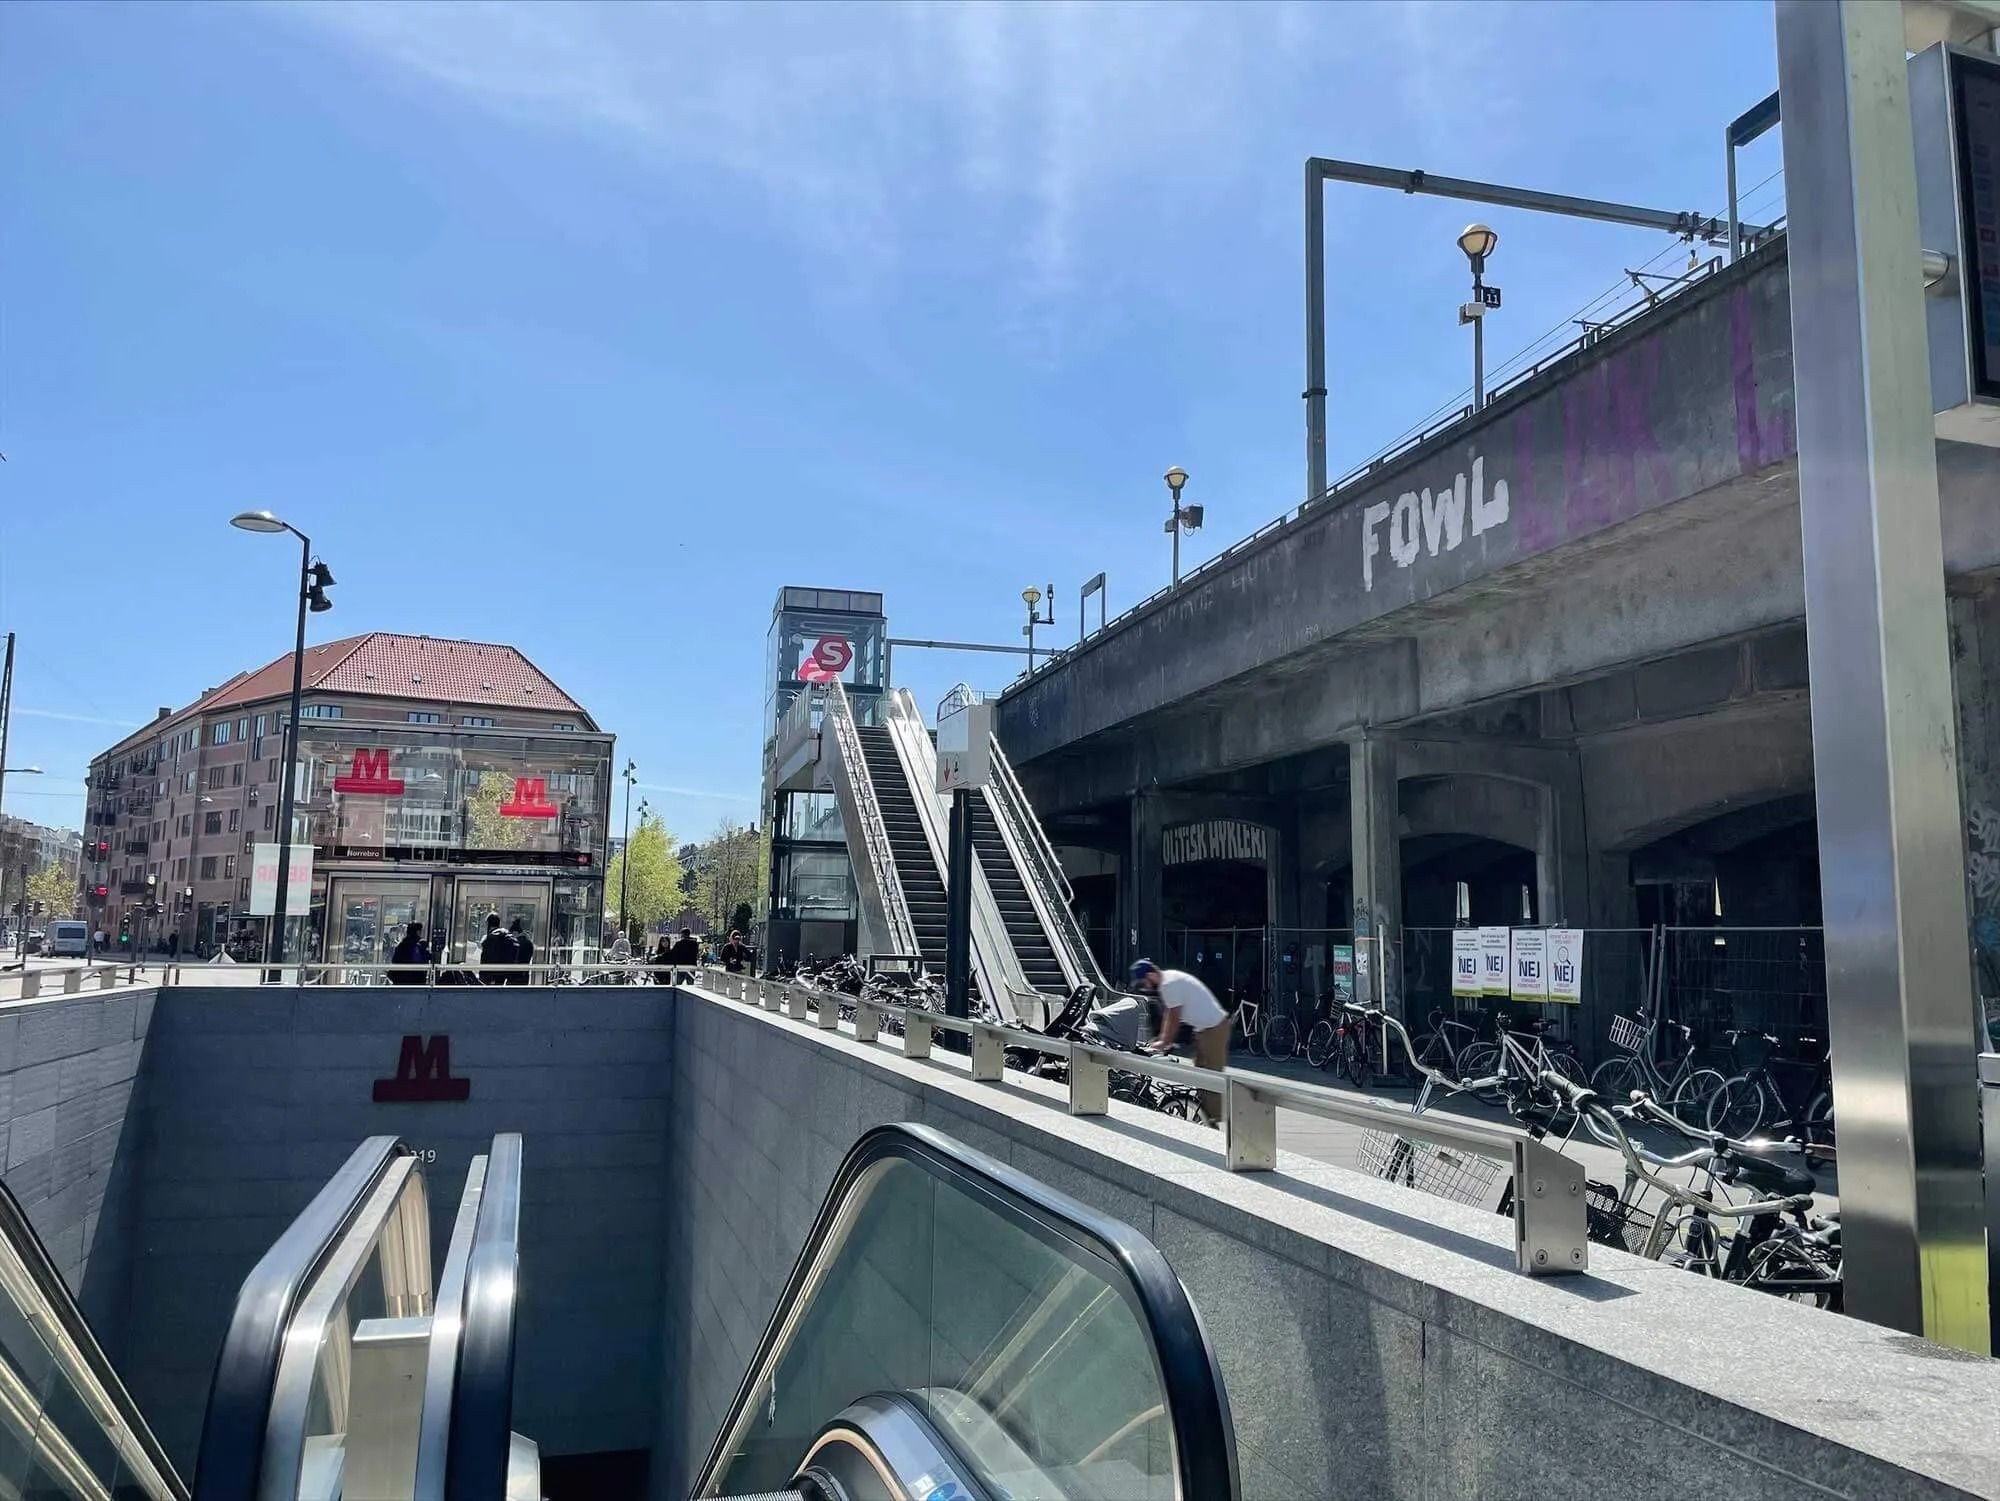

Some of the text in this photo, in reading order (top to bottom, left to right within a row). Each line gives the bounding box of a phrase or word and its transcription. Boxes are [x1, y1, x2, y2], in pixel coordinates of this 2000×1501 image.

[1486, 293, 1499, 305] 11
[1362, 456, 1510, 592] FOWL
[821, 641, 844, 666] S
[1458, 957, 1477, 975] NEJ
[1486, 955, 1504, 973] NEJ
[1519, 960, 1541, 978] NEJ
[1554, 965, 1574, 983] NEJ
